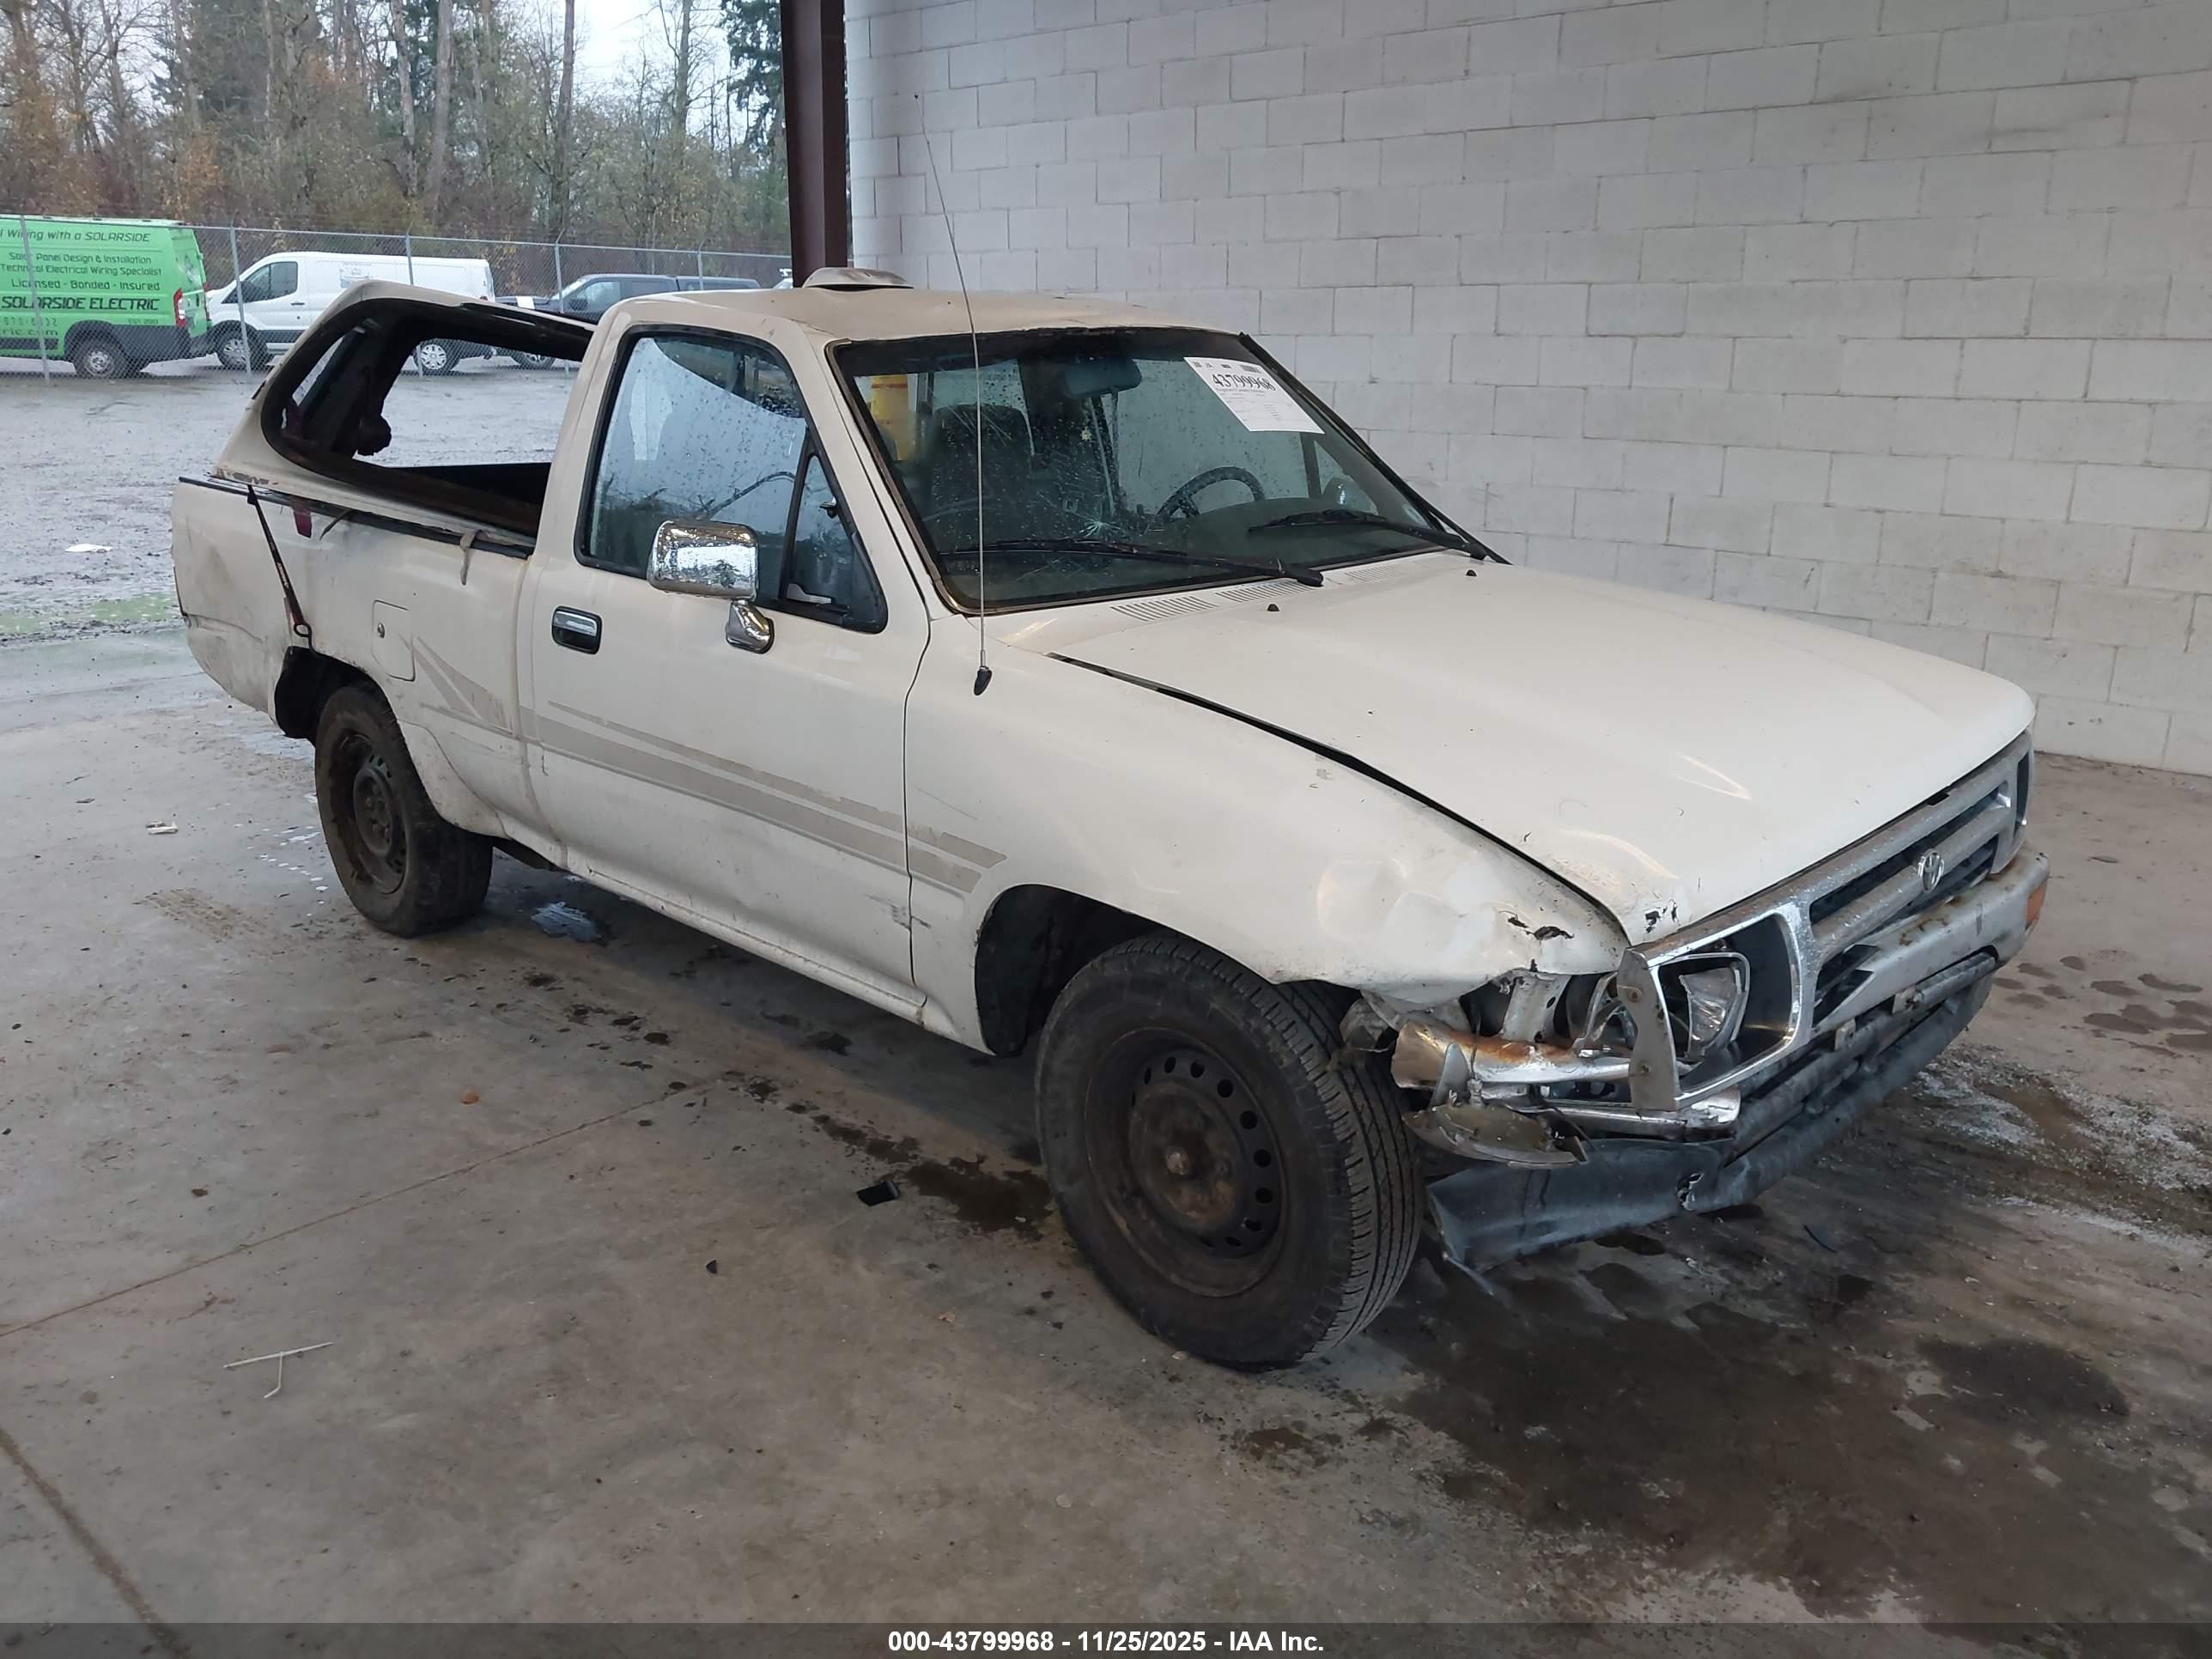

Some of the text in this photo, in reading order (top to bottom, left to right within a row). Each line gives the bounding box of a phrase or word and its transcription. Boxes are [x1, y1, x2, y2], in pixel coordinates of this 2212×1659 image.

[47, 231, 70, 240] with
[85, 232, 150, 242] SOLARSIDE
[36, 252, 61, 262] Panel
[63, 253, 94, 264] Design
[104, 255, 152, 264] Installation
[0, 263, 161, 276] Technal Electrical Wiring Specialist
[70, 280, 111, 290] Bonded
[119, 281, 161, 291] Insured
[89, 297, 161, 311] ELECTRIC
[1212, 374, 1276, 391] 43799968
